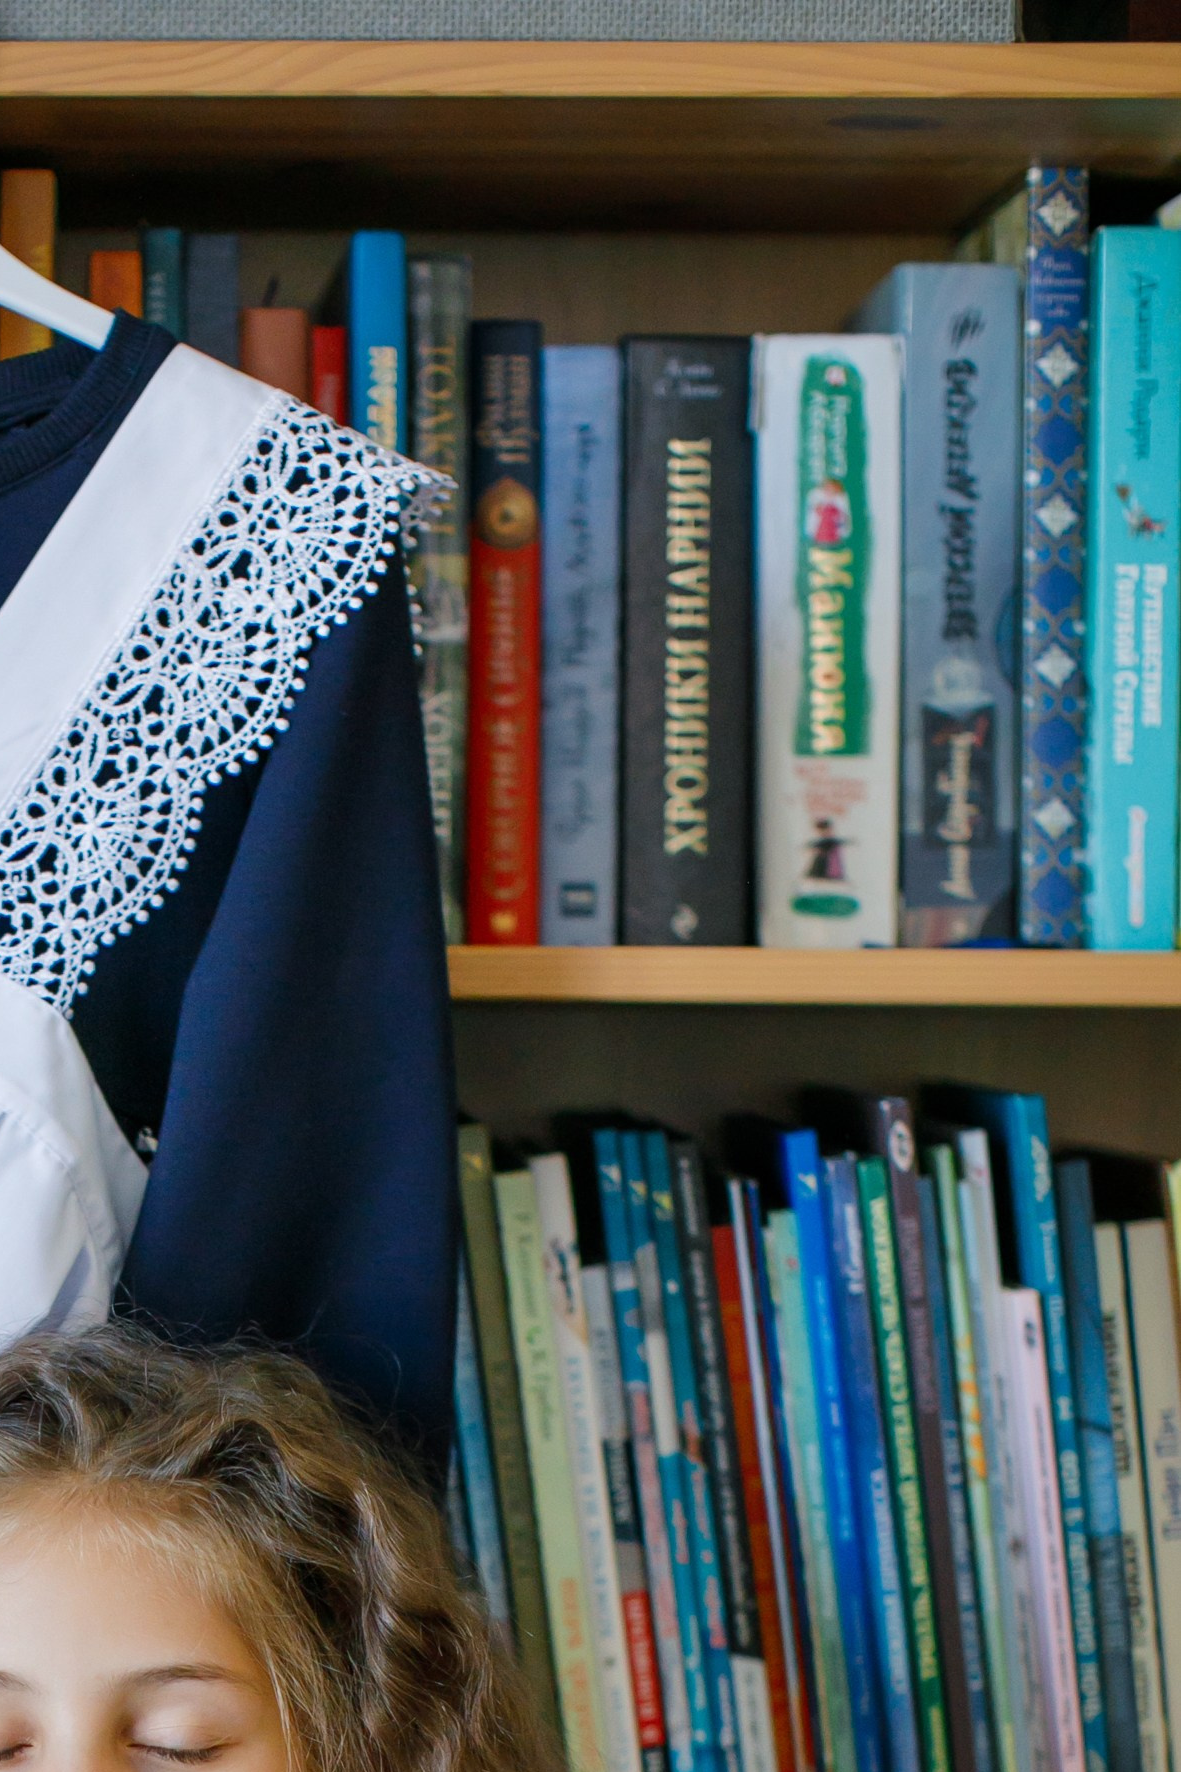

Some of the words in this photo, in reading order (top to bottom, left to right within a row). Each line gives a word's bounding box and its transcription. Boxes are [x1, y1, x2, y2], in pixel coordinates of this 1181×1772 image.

[665, 438, 712, 627] НАРНИИ
[664, 637, 711, 856] ХРОНИКИ
[808, 547, 853, 754] Манюня
